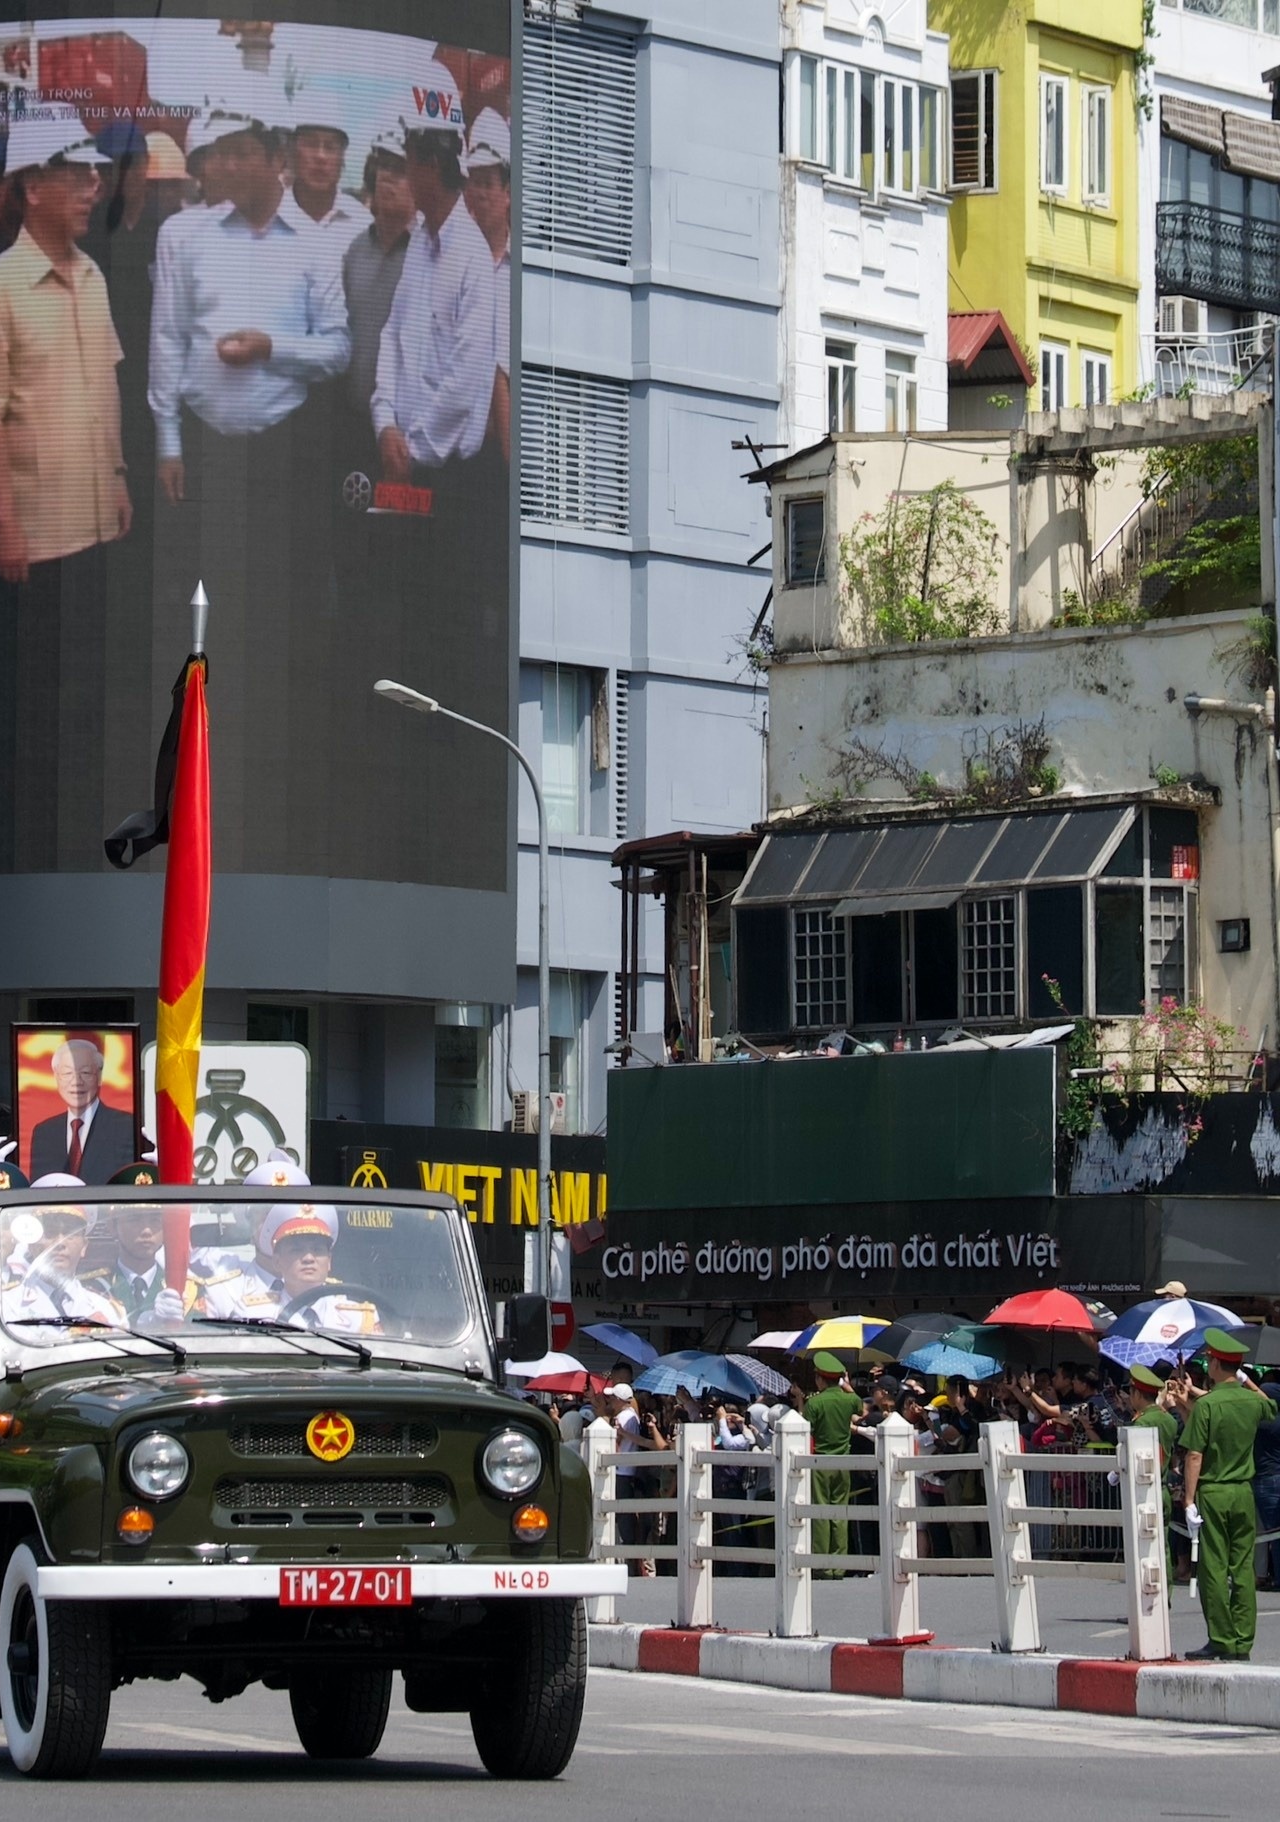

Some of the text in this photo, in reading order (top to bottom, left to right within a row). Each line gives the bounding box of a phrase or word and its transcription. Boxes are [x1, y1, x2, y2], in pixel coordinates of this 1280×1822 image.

[347, 1209, 393, 1229] CHARME
[602, 1229, 1059, 1282] Cà phê đường phố đậm đà chất Việt
[284, 1570, 404, 1602] TM-27-01
